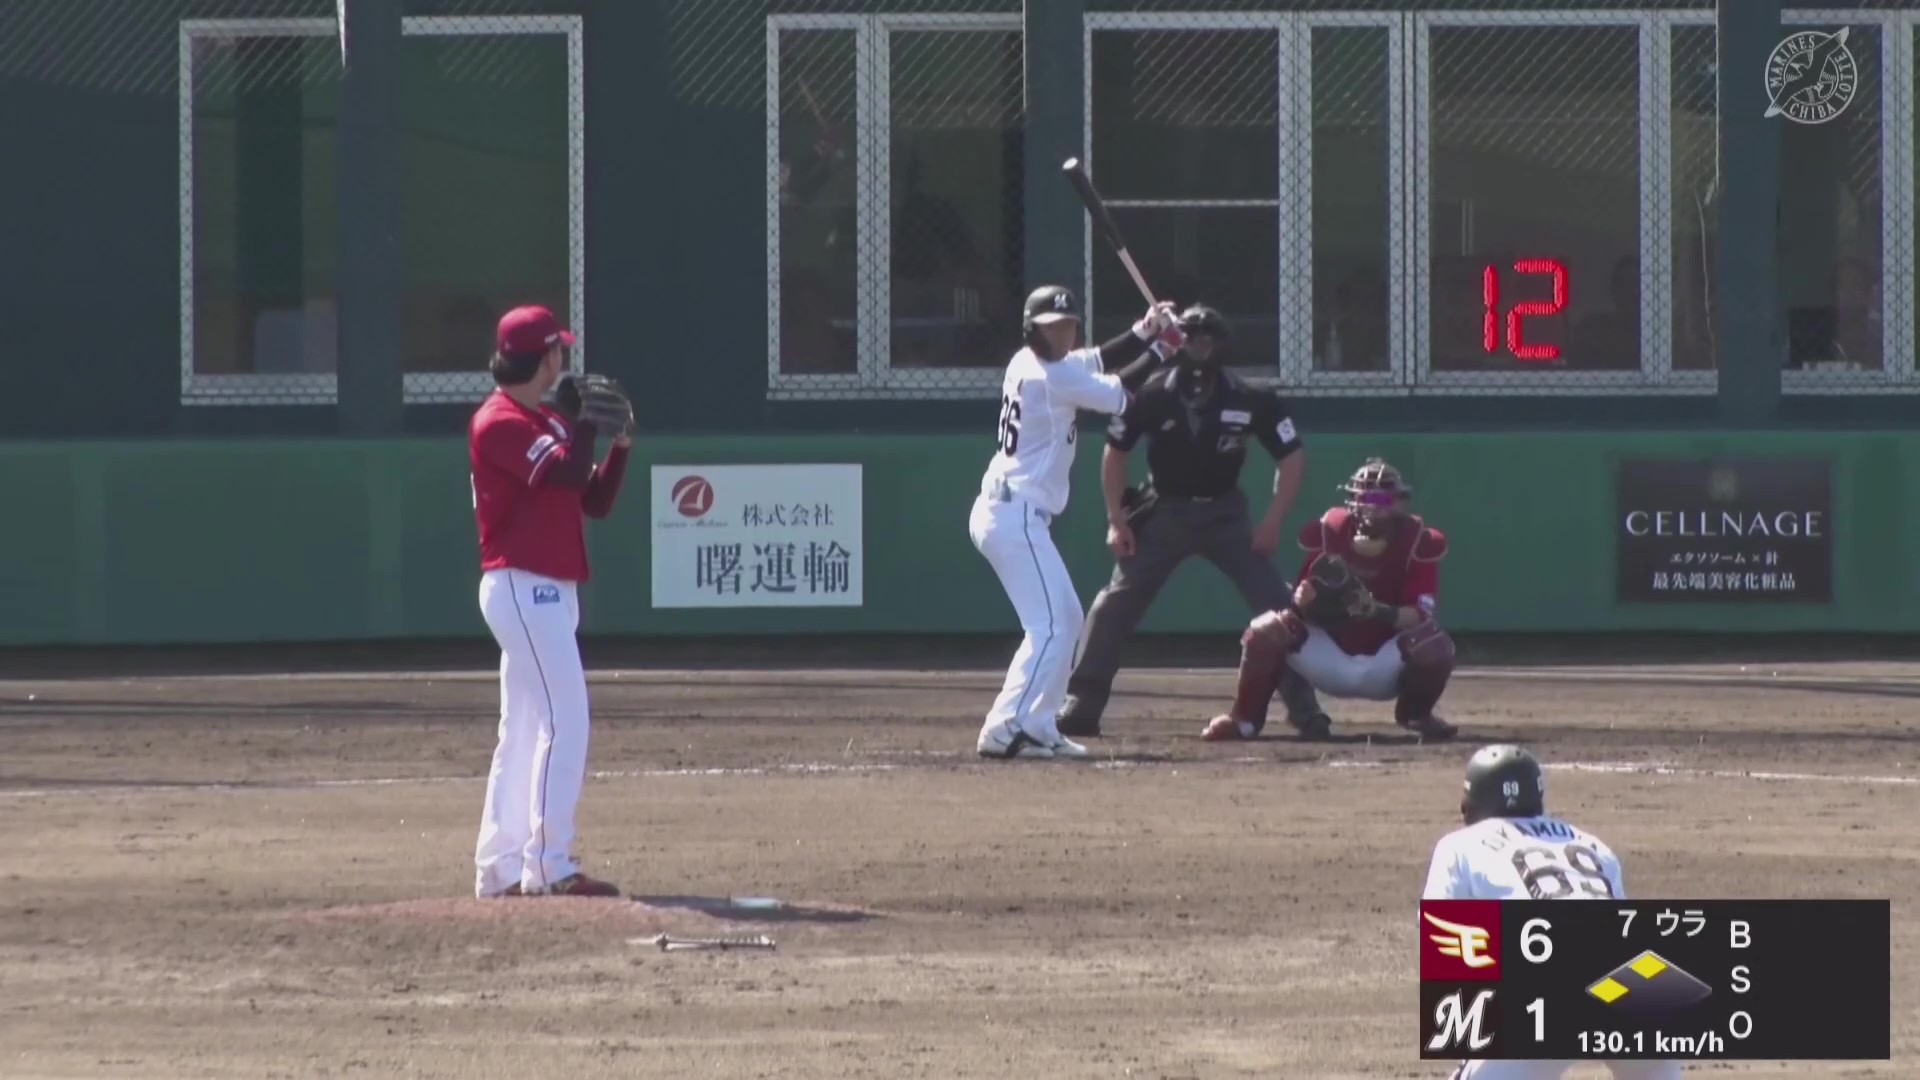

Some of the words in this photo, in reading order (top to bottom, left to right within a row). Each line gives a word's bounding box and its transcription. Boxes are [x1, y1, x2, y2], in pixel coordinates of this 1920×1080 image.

[1484, 260, 1568, 358] 12
[742, 503, 834, 527] 株式会社
[1626, 511, 1822, 536] CELLNAGE
[697, 541, 851, 595] 曙運輸
[1653, 572, 1795, 590] 最先端美容化粧品
[1503, 781, 1519, 796] 69
[1511, 844, 1614, 899] 69
